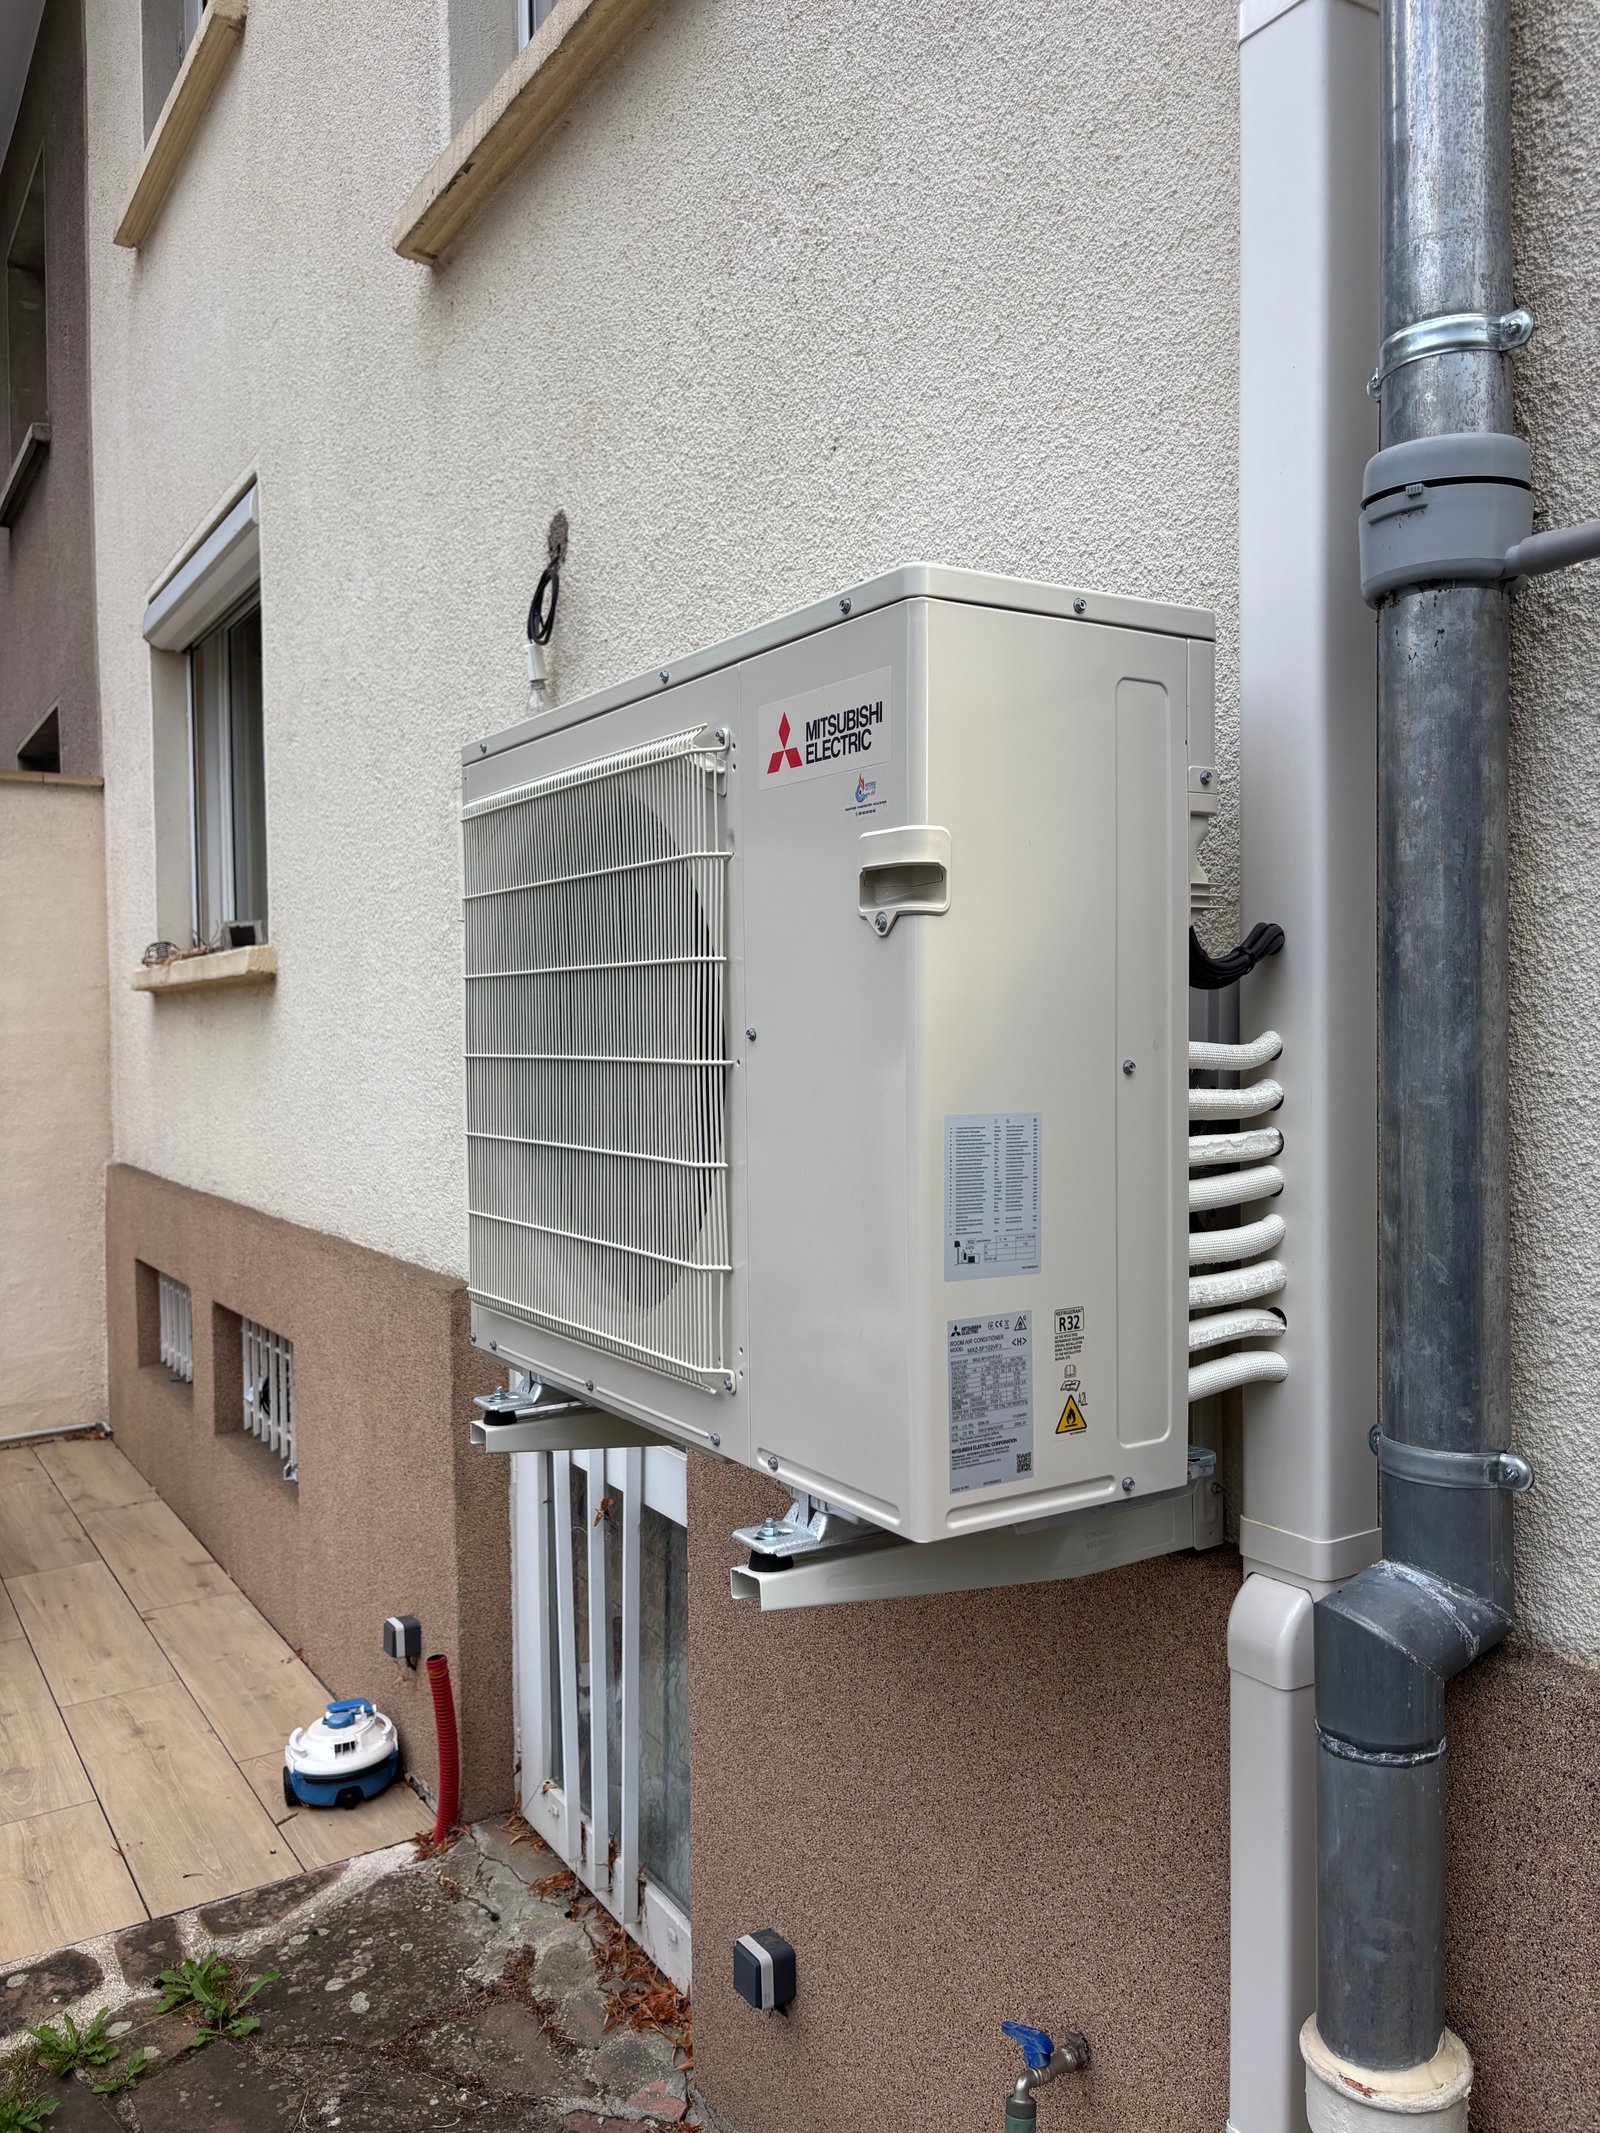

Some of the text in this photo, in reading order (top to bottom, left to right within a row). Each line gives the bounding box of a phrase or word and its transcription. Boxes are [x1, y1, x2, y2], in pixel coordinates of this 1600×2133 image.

[805, 701, 883, 742] MITSUBISHI
[805, 728, 872, 765] ELECTRIC
[1059, 1315, 1080, 1331] R32
